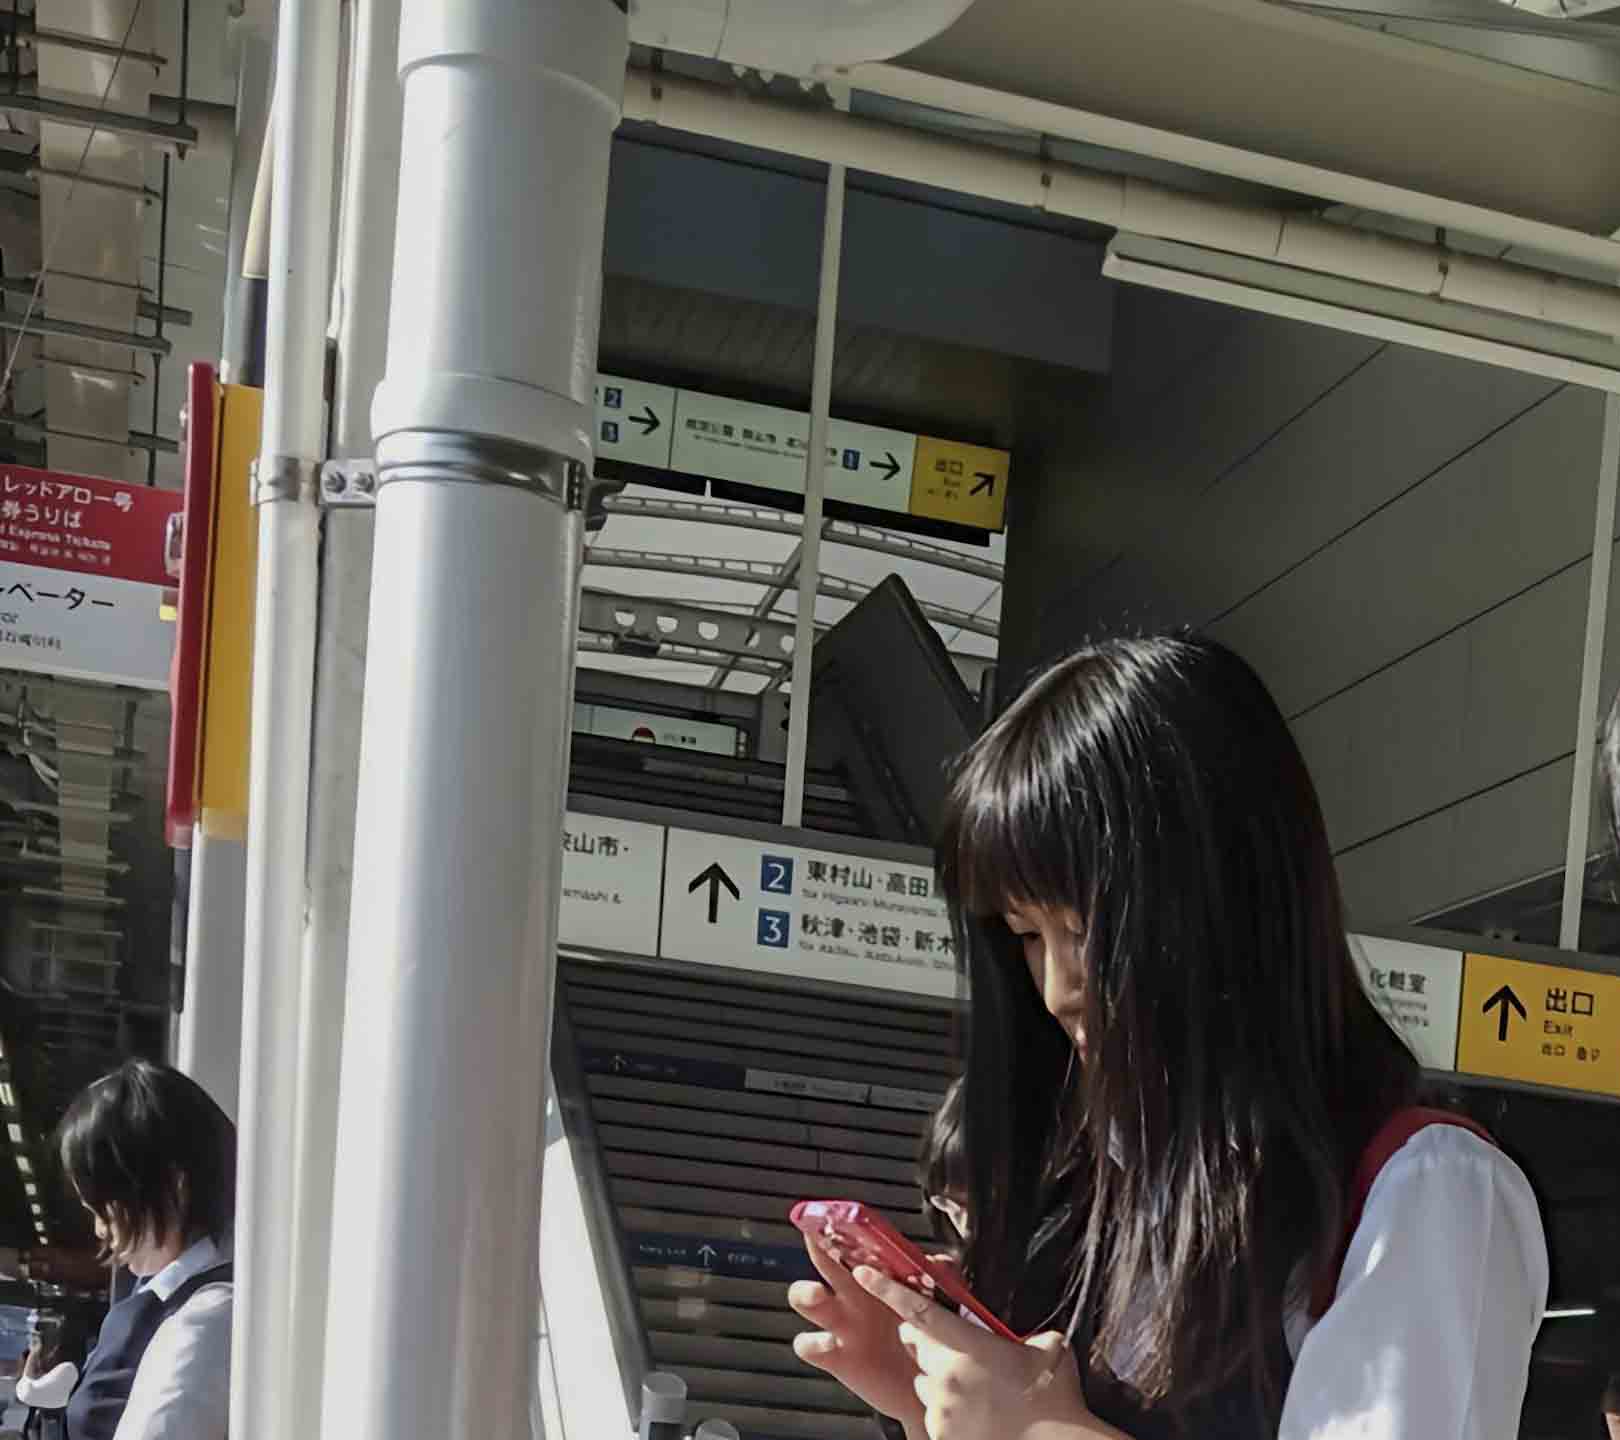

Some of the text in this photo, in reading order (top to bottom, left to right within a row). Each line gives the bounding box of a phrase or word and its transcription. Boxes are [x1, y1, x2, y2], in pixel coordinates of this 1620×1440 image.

[768, 865, 786, 889] 2
[763, 917, 782, 942] 3
[1545, 987, 1595, 1016] 出口
[1543, 1019, 1574, 1037] Exit
